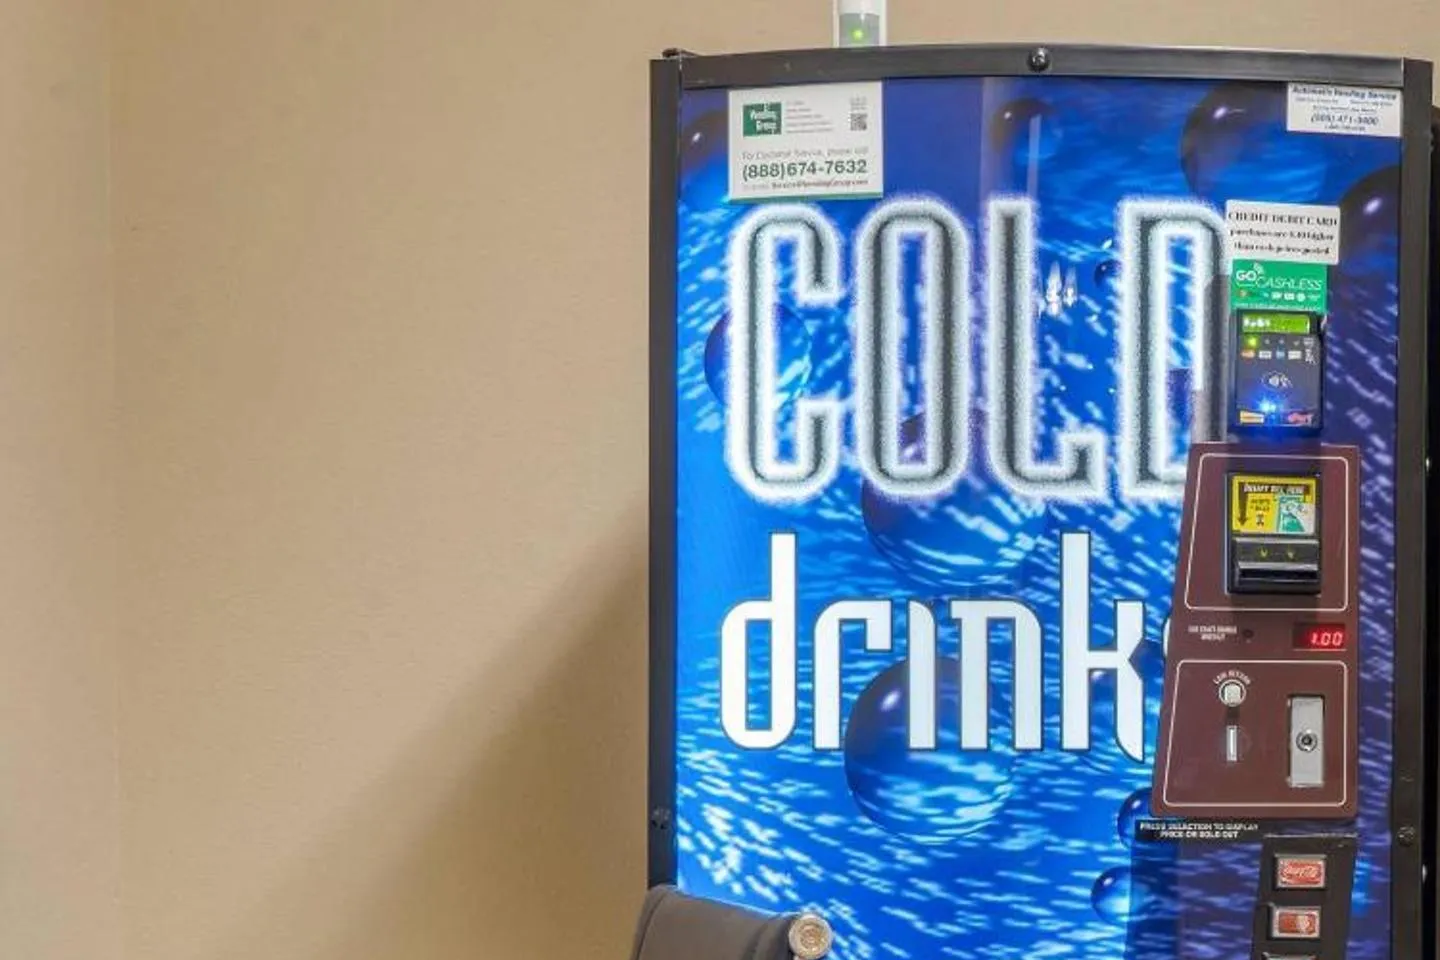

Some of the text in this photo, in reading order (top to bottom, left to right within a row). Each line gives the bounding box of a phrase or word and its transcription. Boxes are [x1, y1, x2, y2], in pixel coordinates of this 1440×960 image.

[742, 159, 868, 182] (888)674-7632
[1236, 270, 1323, 290] GO CASHLESS
[726, 195, 1232, 502] COLD
[1310, 631, 1344, 647] 1.00
